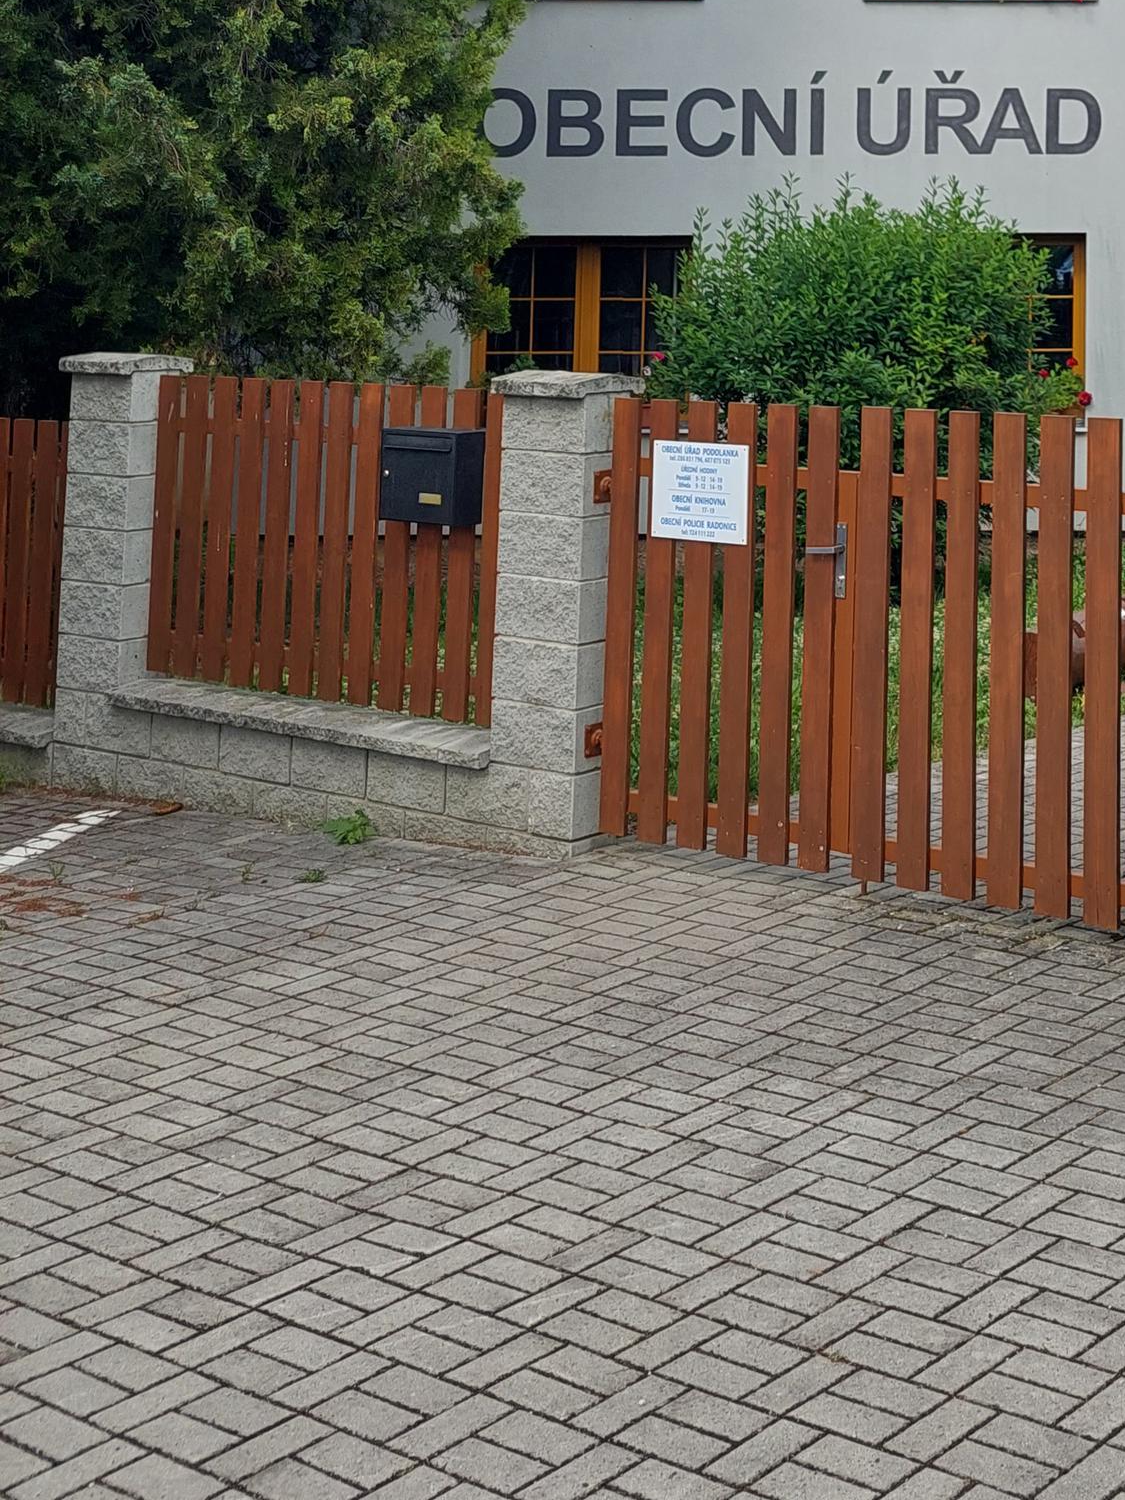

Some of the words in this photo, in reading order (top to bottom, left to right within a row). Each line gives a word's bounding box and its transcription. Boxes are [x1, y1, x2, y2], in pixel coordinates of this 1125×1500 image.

[481, 70, 828, 158] OBECNÍ
[856, 69, 1102, 156] ÚŘAD
[661, 445, 682, 454] OBECNÍ
[684, 445, 701, 455] ÚŘAD
[702, 447, 739, 457] PODOLANKA
[681, 464, 698, 473] ÚŘEDNÍ
[671, 494, 692, 504] OBECNÍ
[694, 496, 726, 506] KNIHOVNA
[660, 517, 682, 526] OBECNÍ
[683, 519, 705, 529] POLICIE
[706, 520, 737, 531] RADONICE
